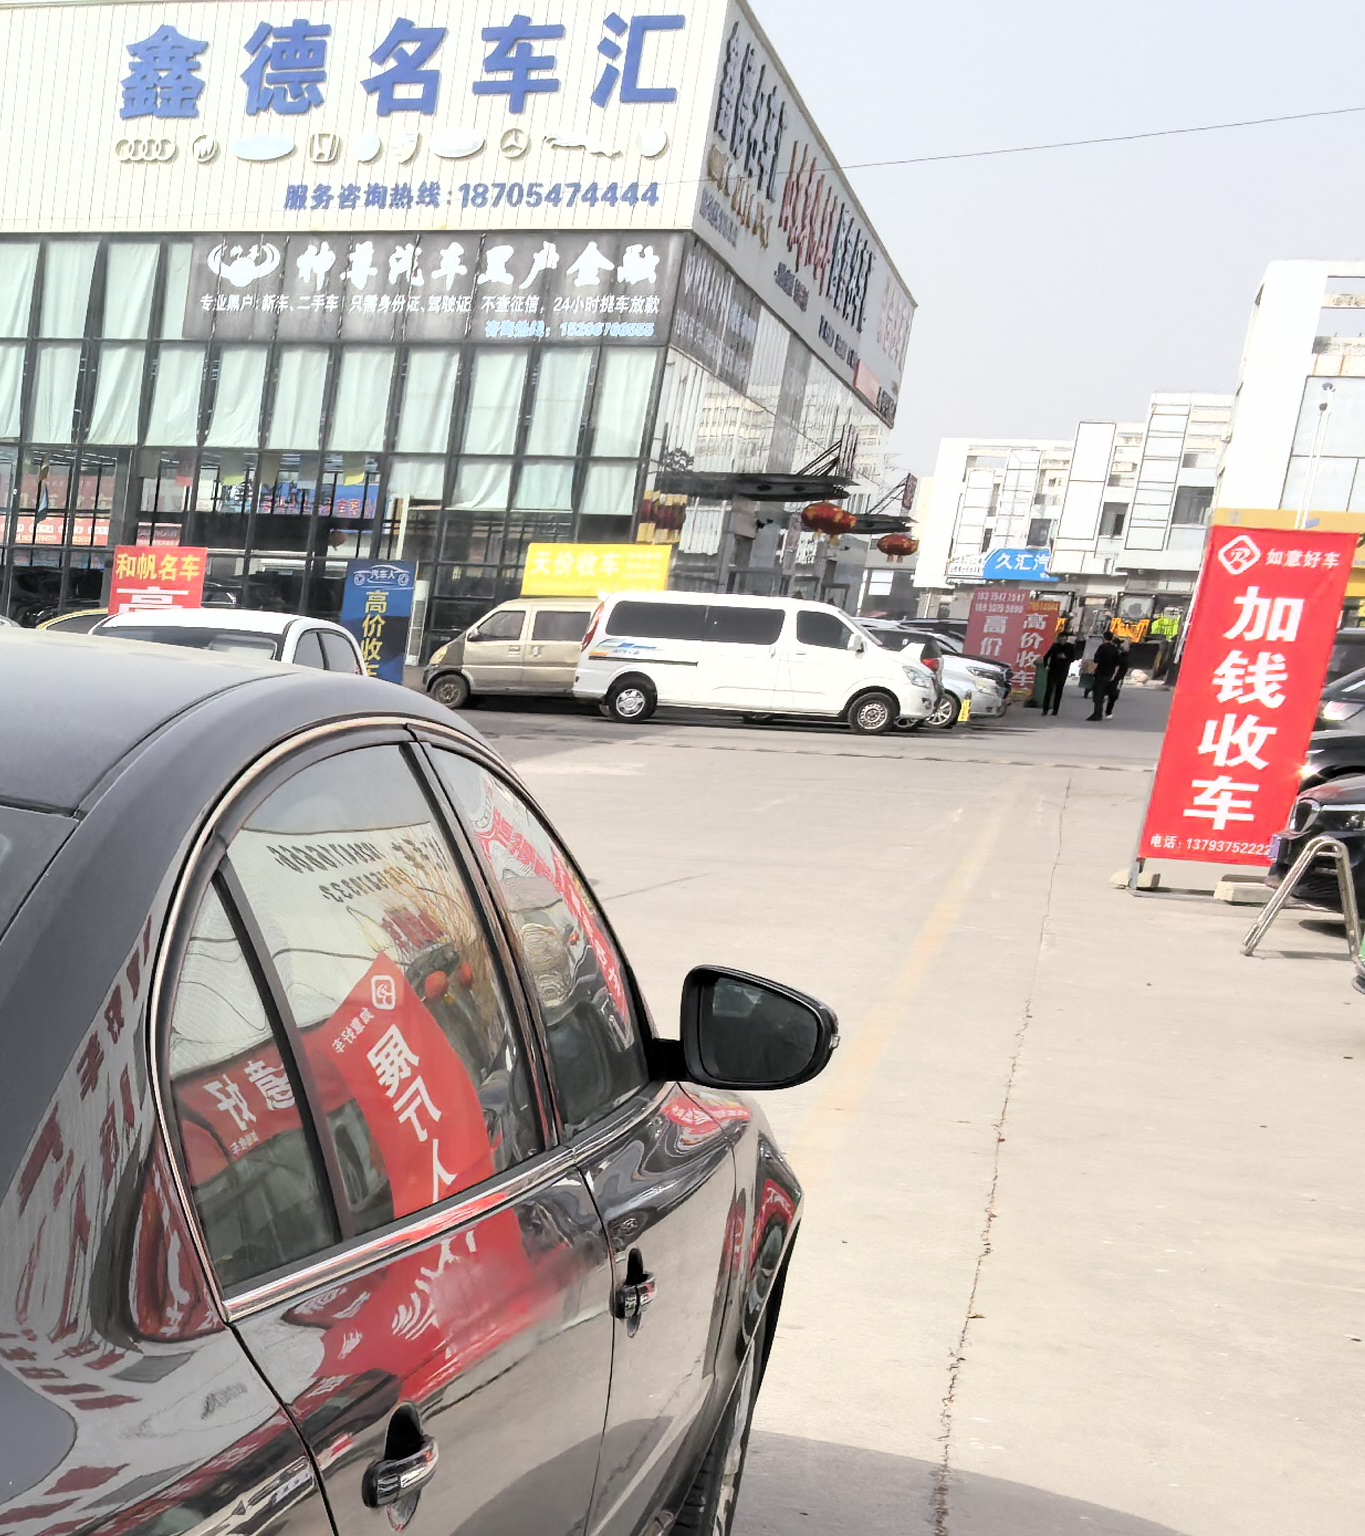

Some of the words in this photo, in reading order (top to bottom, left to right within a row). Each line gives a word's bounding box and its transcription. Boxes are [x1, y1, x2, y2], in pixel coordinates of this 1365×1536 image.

[119, 12, 686, 119] 鑫德名车汇
[284, 181, 660, 210] 服务咨询热线:18705474444
[116, 553, 201, 582] 和帆名车
[531, 551, 621, 577] 天价收车
[1265, 548, 1341, 569] 如意好车
[1184, 586, 1305, 831] 加钱收车
